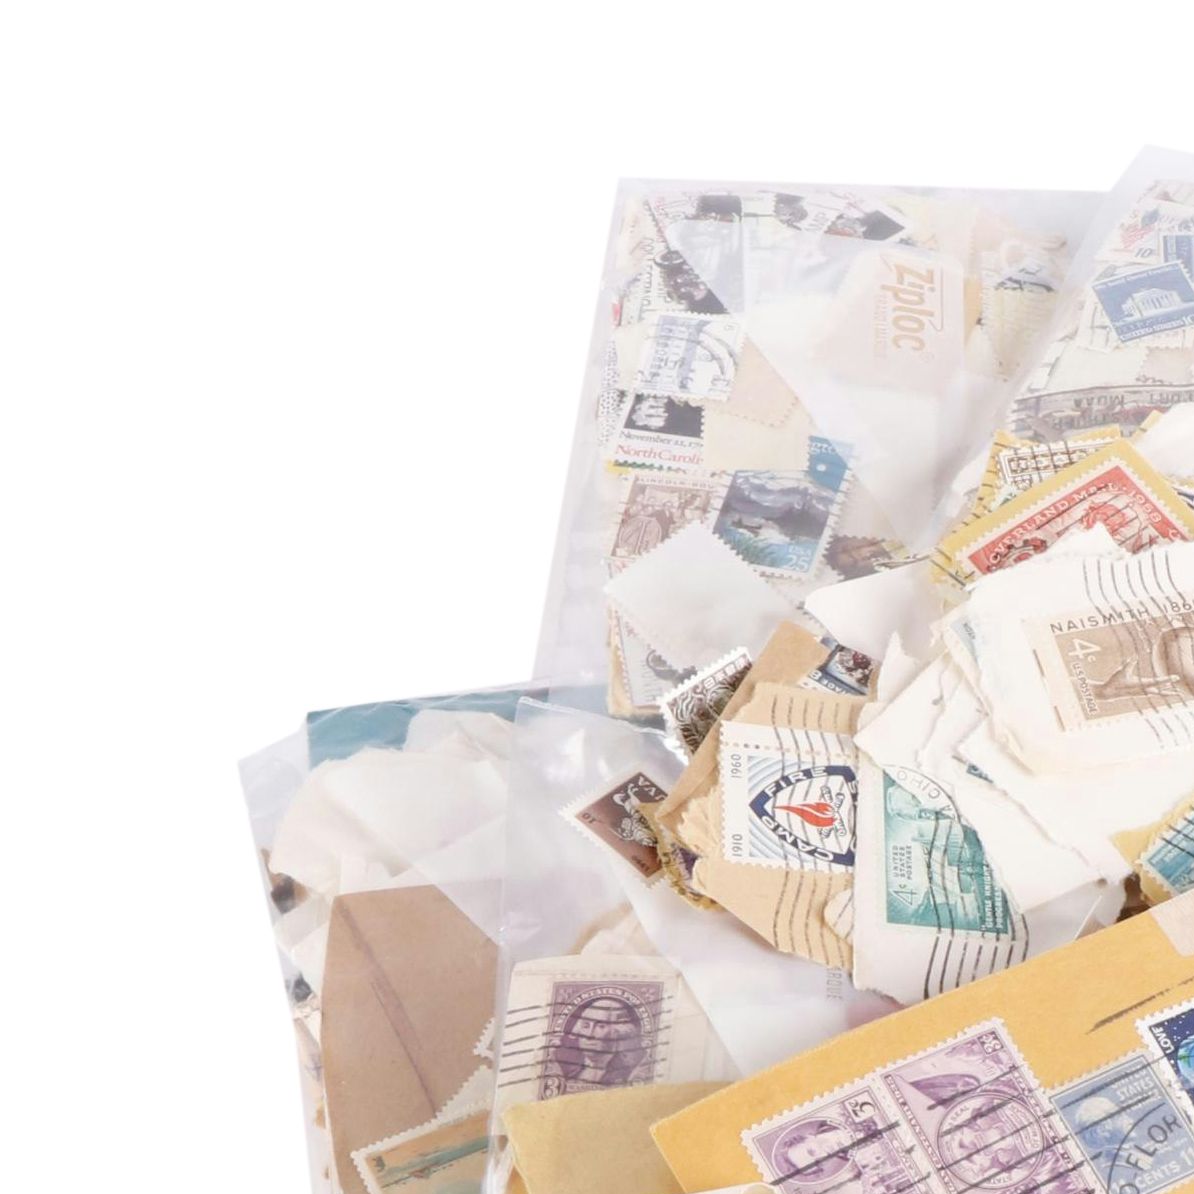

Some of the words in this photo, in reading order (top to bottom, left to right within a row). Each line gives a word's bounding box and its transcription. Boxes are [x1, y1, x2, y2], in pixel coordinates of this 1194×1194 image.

[881, 262, 936, 352] Ziploc
[620, 429, 674, 447] November
[785, 553, 809, 572] 25
[1049, 607, 1150, 634] NAISMITH
[730, 753, 743, 779] 1960
[764, 765, 827, 799] FIRE
[731, 832, 744, 858] 1910
[760, 815, 834, 862] CAMP
[1151, 1026, 1175, 1055] LOVE
[1115, 1074, 1154, 1102] STATES
[1134, 1160, 1181, 1188] CENTS
